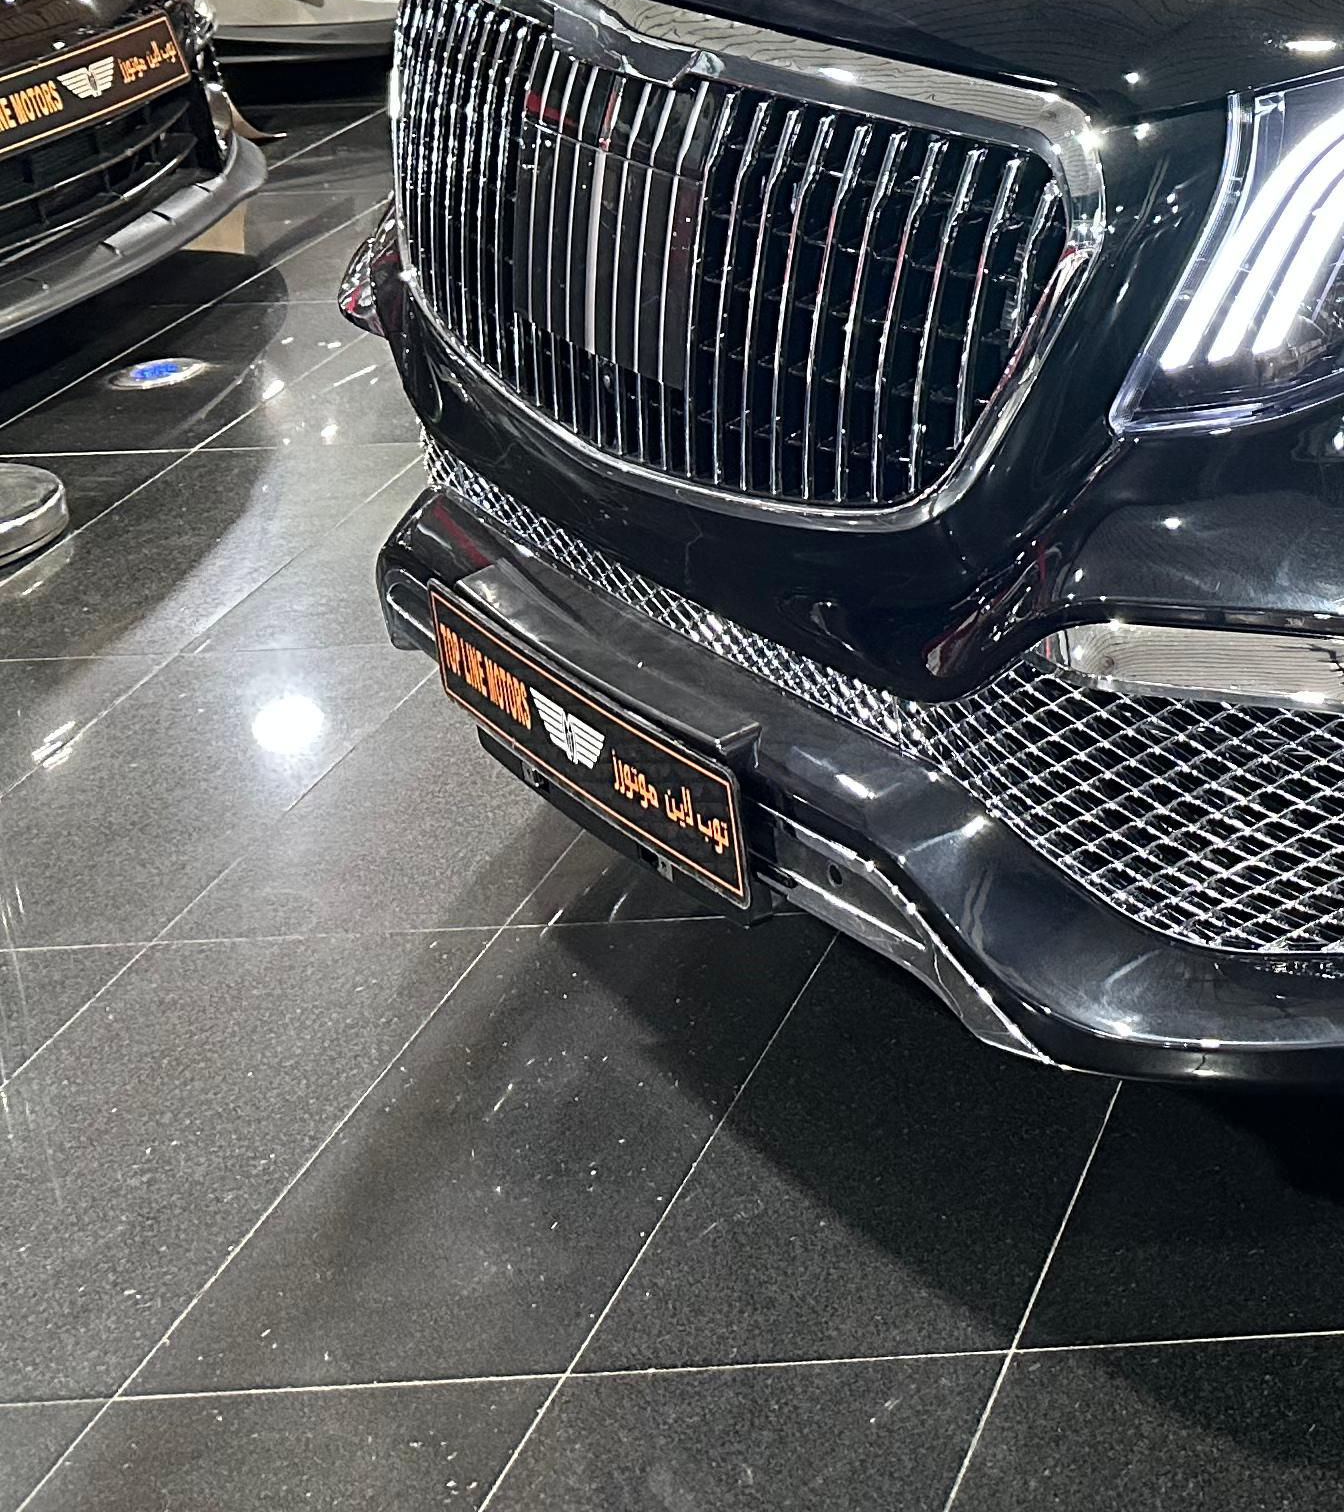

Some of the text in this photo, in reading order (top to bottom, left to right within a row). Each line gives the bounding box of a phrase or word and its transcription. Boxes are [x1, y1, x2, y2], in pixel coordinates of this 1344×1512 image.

[9, 80, 63, 126] MOTORS
[440, 622, 532, 731] TOP LINE MOTORS
[611, 748, 730, 854] توب لاين موتورز
